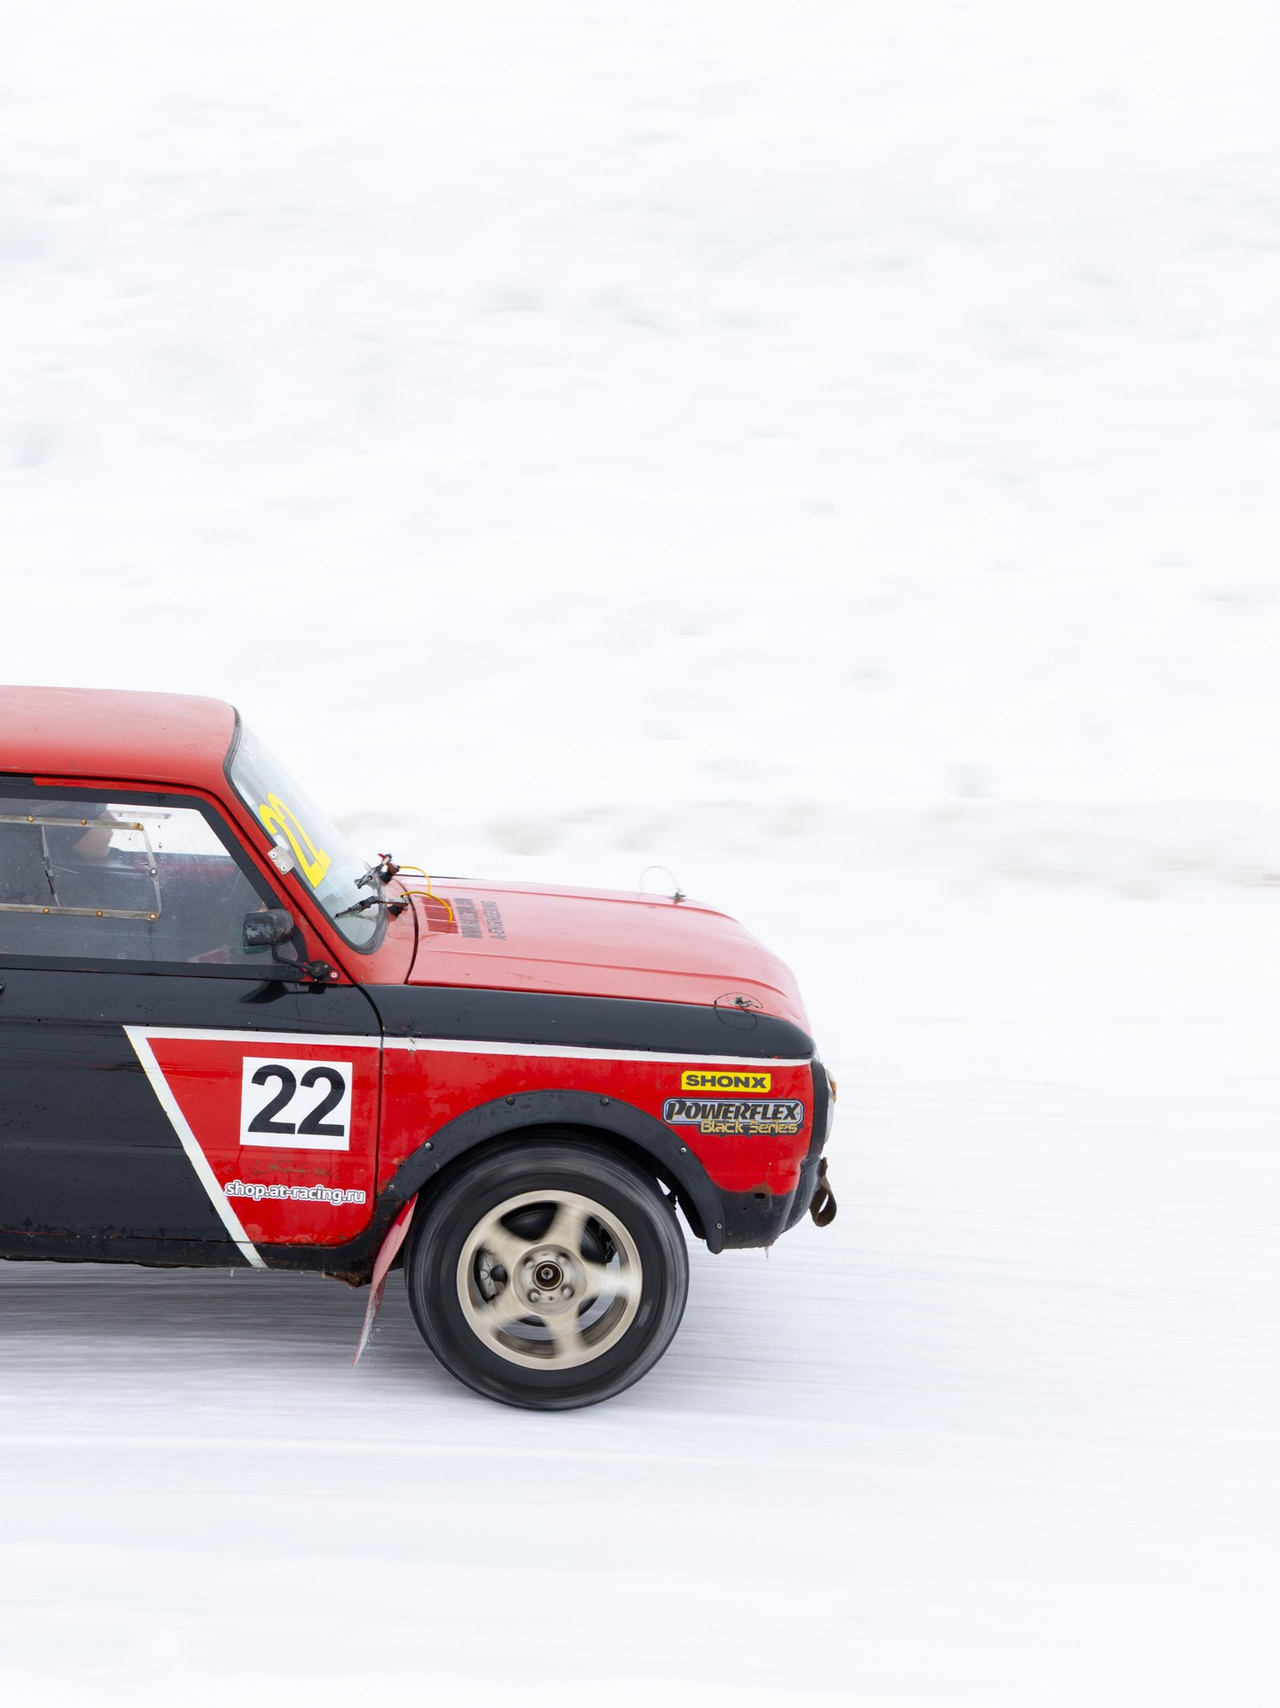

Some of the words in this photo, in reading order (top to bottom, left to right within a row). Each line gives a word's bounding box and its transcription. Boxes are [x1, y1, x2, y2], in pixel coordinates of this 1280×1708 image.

[259, 792, 331, 889] 22
[685, 1074, 767, 1089] SHONX
[247, 1064, 346, 1137] 22
[665, 1100, 800, 1121] POWERFLEX
[700, 1120, 744, 1134] Black
[749, 1121, 798, 1134] Series
[225, 1181, 366, 1204] shop.at-racing.ru
